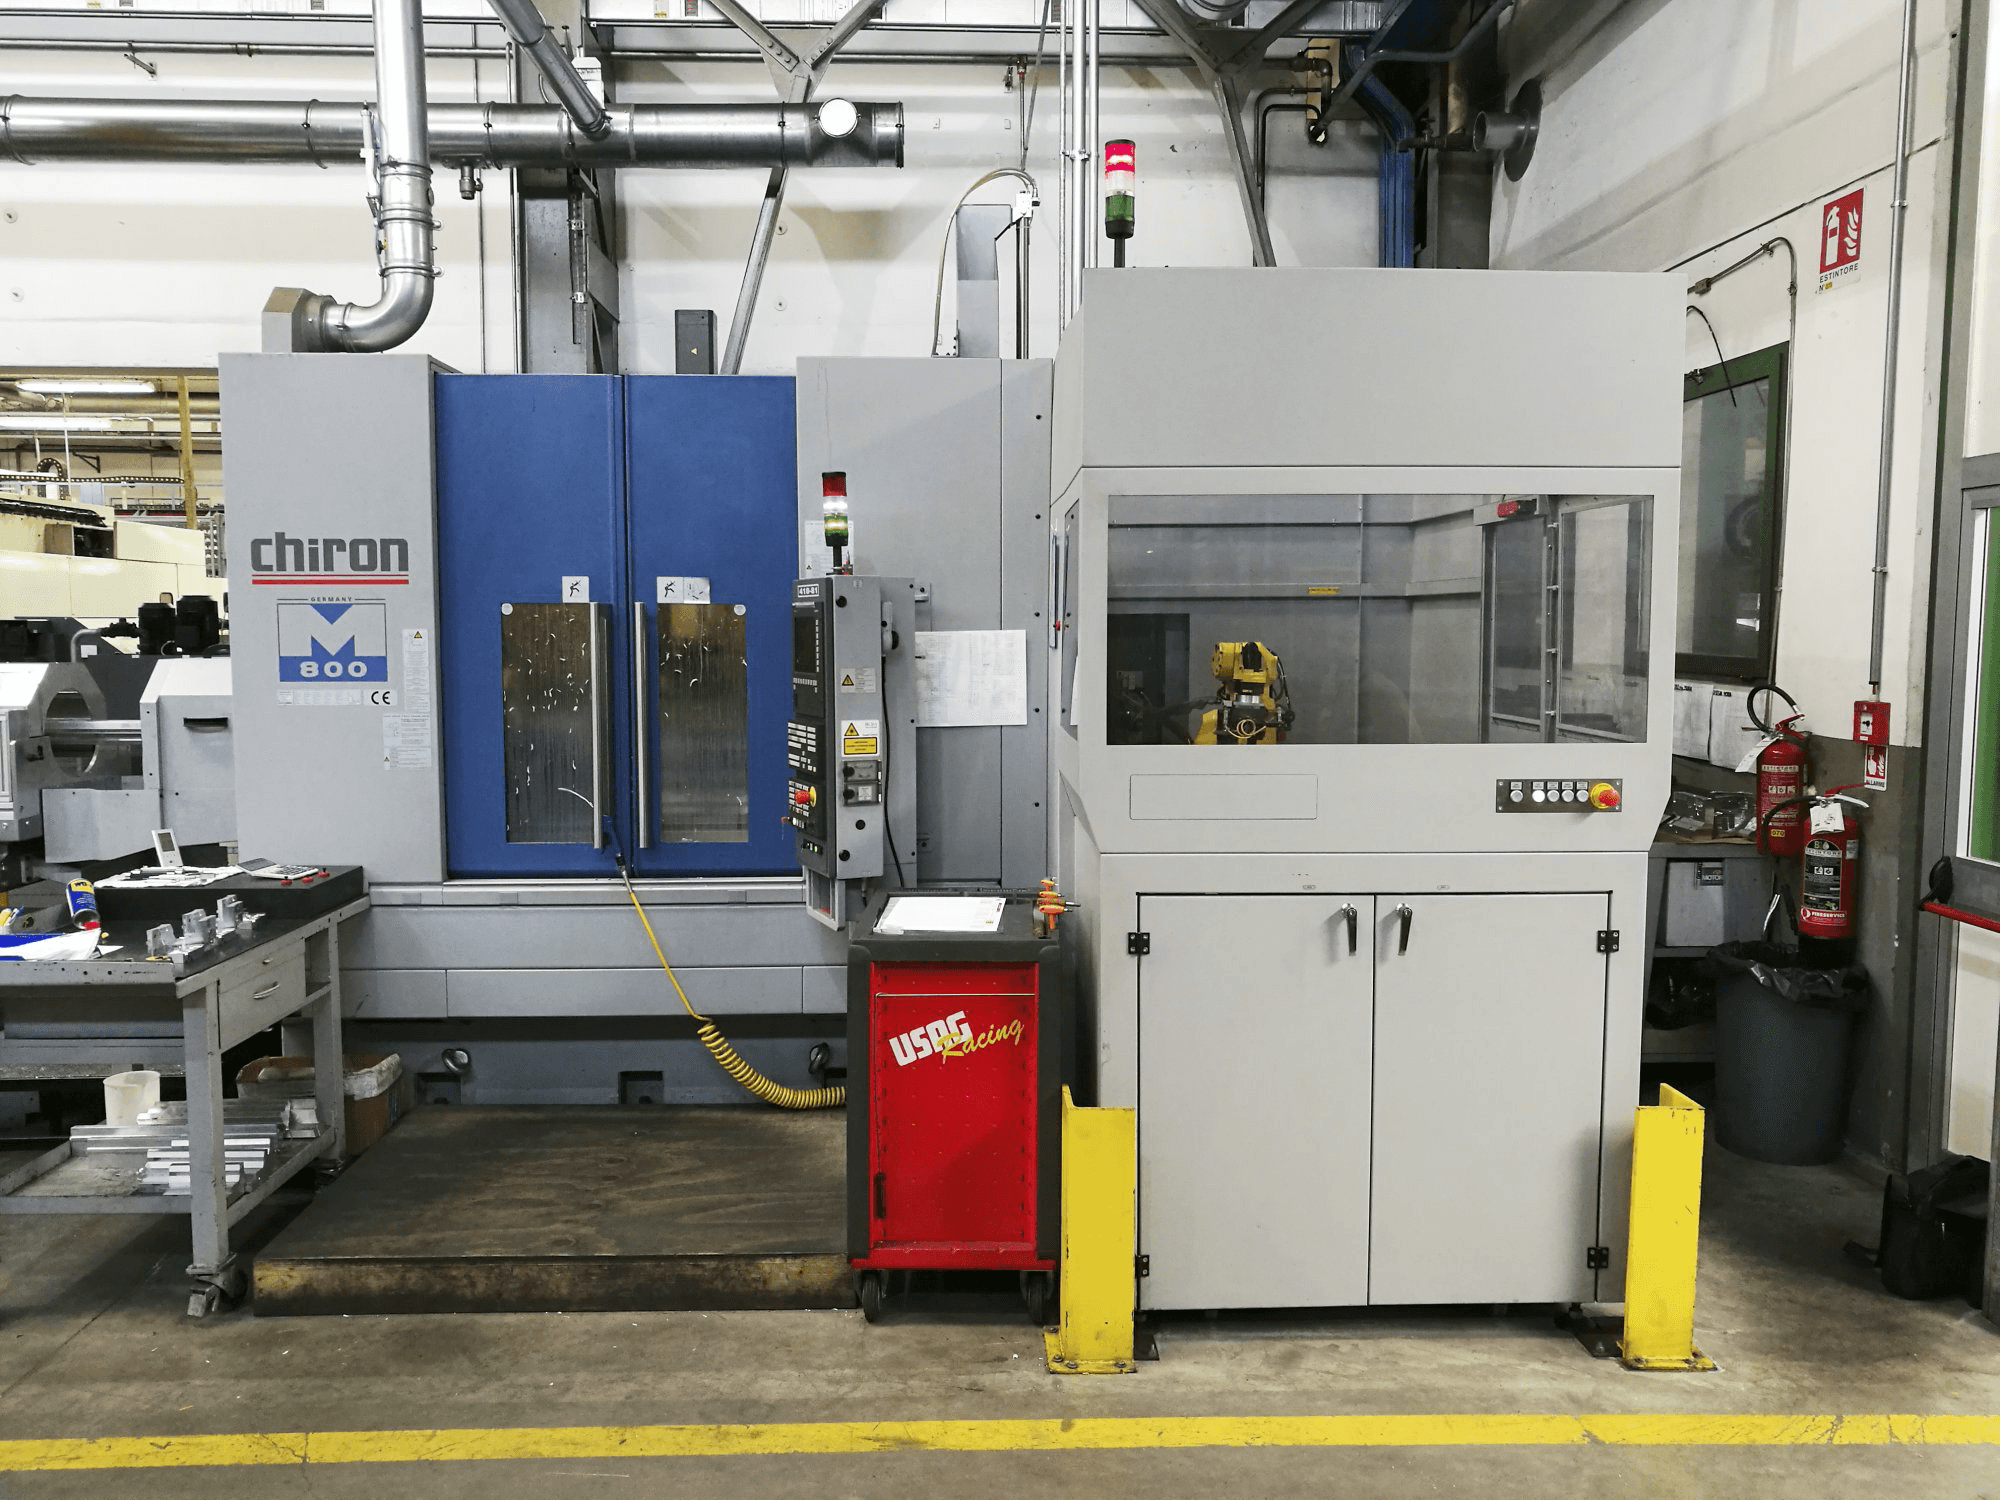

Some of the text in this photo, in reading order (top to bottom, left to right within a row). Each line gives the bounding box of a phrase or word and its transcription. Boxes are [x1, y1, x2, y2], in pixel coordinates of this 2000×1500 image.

[1819, 263, 1859, 283] ESTINTORE
[250, 531, 410, 572] chiron
[299, 661, 368, 678] 800
[888, 1010, 1025, 1067] USAG Racing
